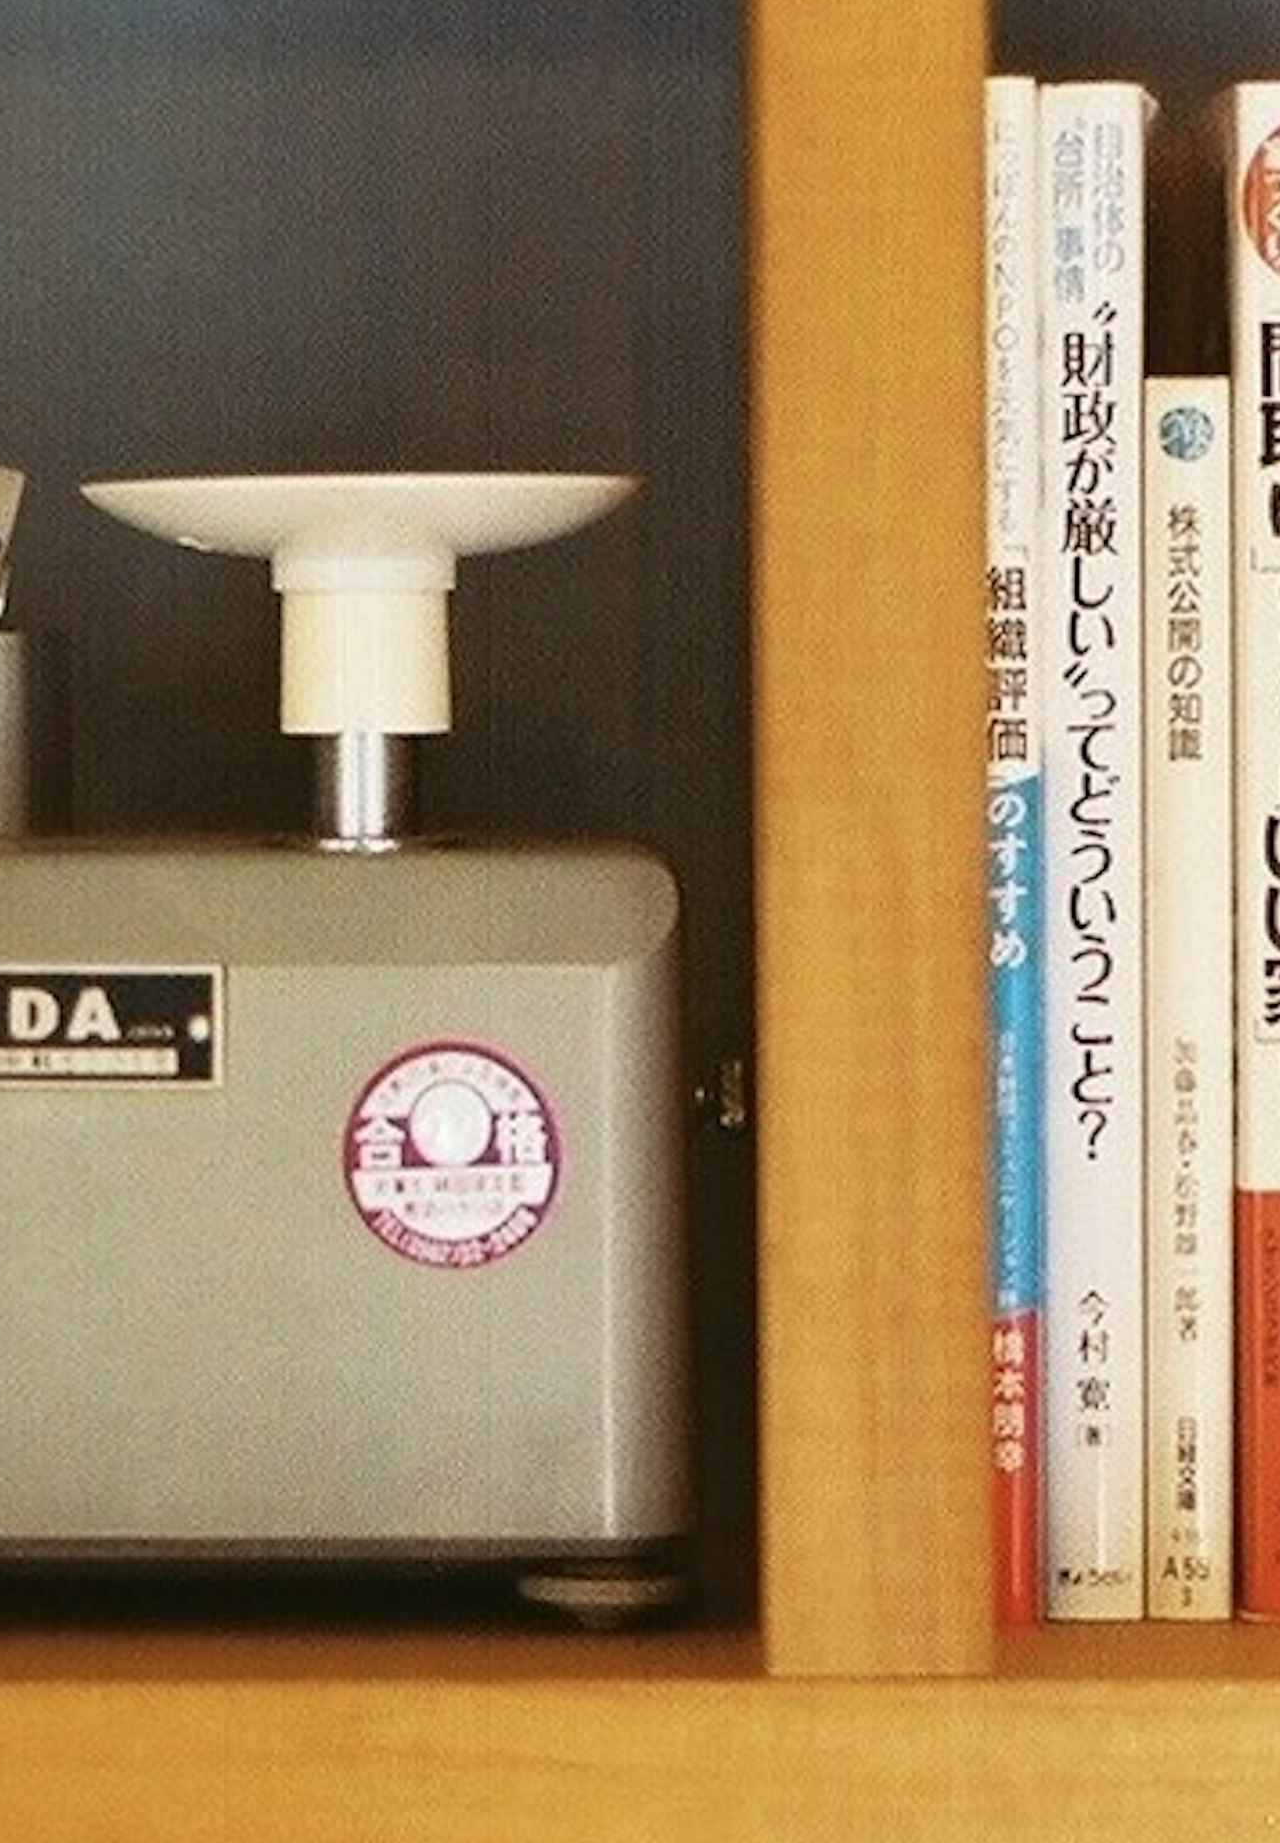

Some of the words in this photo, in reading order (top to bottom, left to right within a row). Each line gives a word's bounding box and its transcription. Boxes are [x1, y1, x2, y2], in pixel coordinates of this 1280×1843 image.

[1165, 502, 1204, 761] 株式公開の知識
